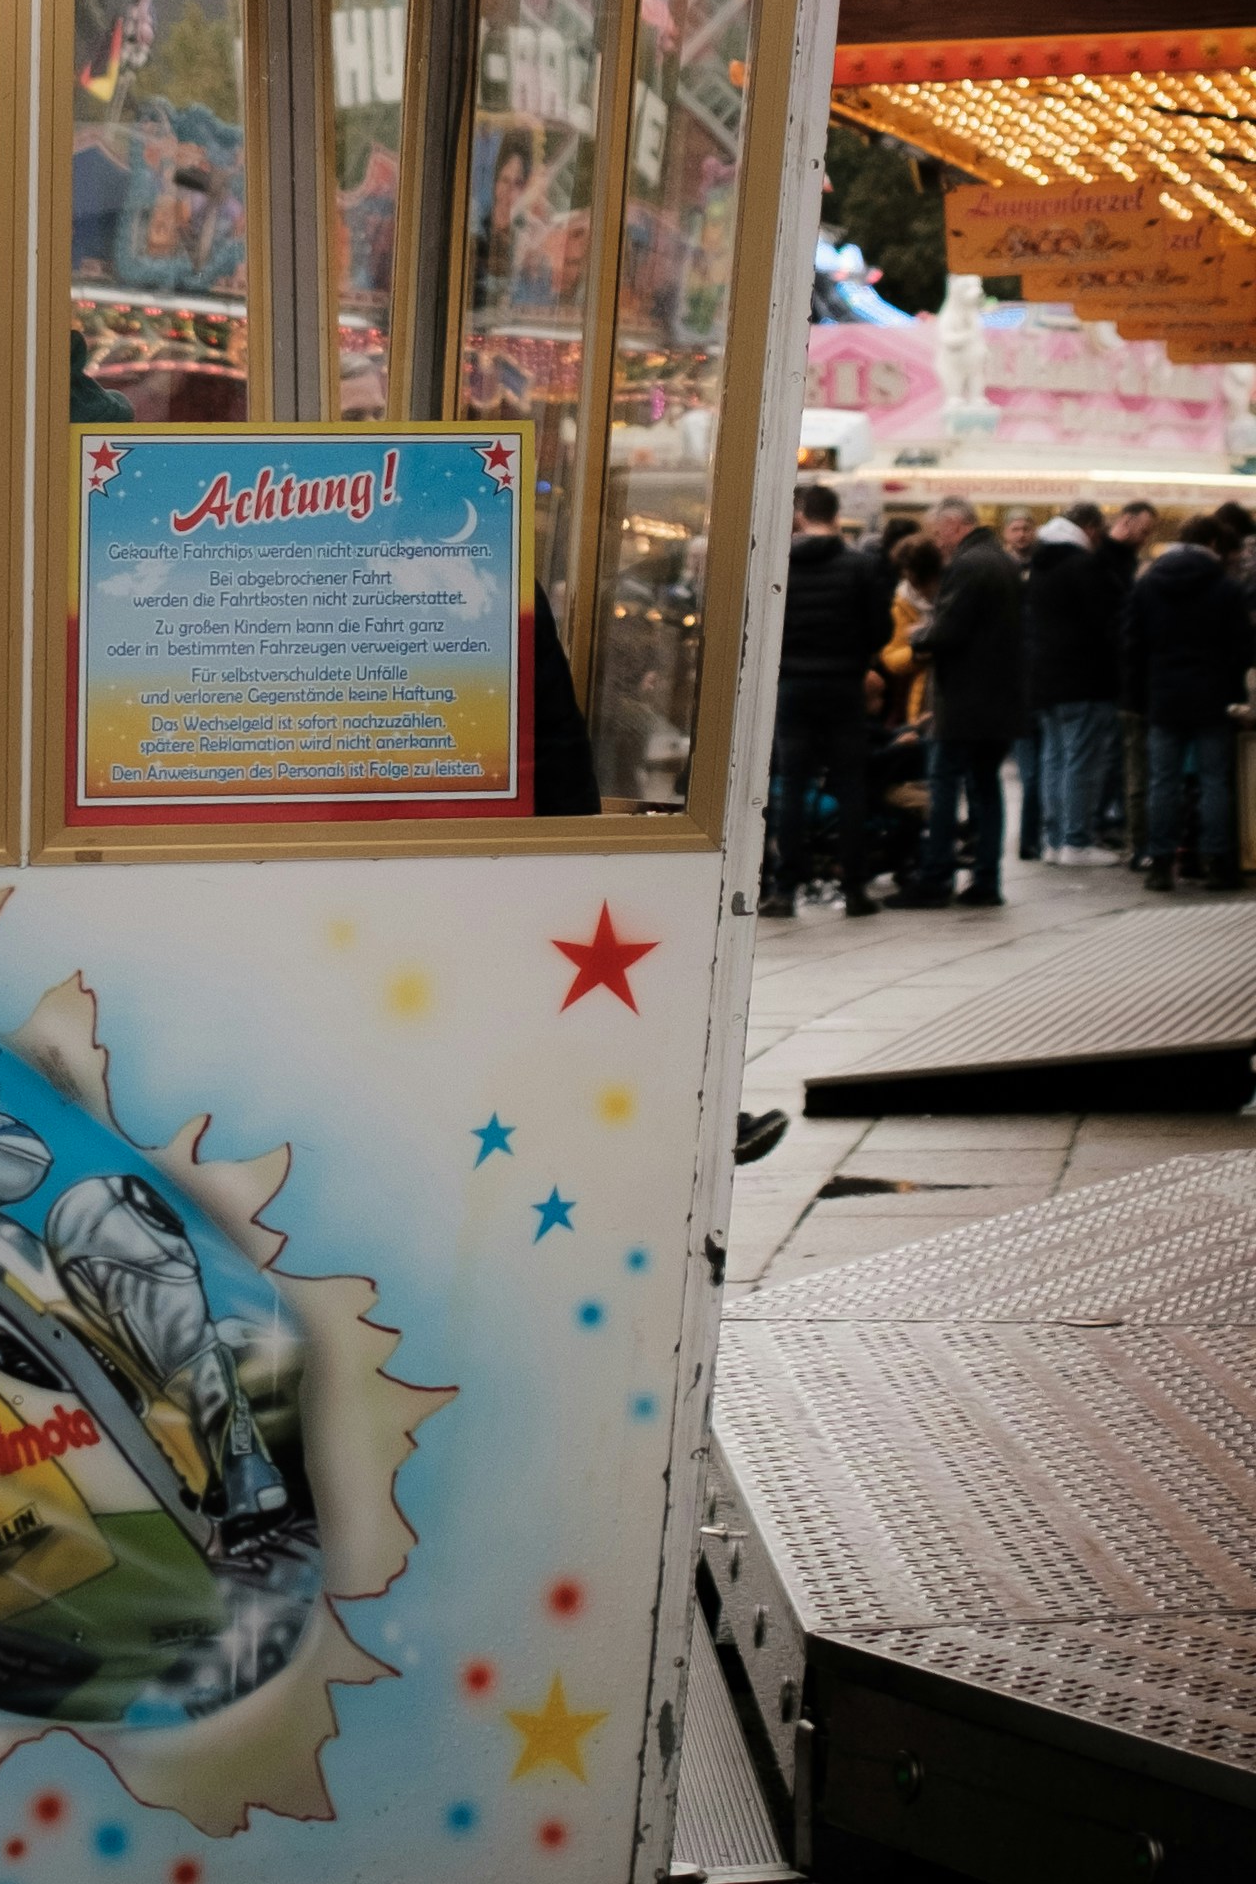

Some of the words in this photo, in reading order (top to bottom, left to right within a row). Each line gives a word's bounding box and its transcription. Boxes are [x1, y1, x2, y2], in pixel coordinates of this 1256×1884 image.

[171, 450, 399, 533] Achtung!
[108, 544, 179, 562] Gekaufte
[183, 544, 254, 562] Fahrchips
[258, 544, 313, 559] werden
[317, 544, 352, 559] nicht
[357, 543, 491, 561] zurückgenommen.
[210, 571, 233, 586] Bei
[238, 570, 347, 590] abgebrochener
[352, 570, 392, 585] Fahrt
[133, 593, 188, 608] werden
[193, 592, 215, 608] die
[220, 592, 309, 608] Fahrtkosten
[313, 591, 348, 606] nicht
[353, 590, 466, 606] zurückerstattet.
[155, 620, 174, 636] Zu
[179, 619, 230, 638] großen
[234, 619, 291, 634] Kindern
[296, 619, 333, 634] kann
[338, 618, 360, 633] die
[365, 618, 404, 633] Fahrt
[409, 621, 445, 636] ganz
[107, 642, 141, 657] oder
[145, 642, 159, 656] in
[168, 640, 255, 656] bestimmten
[259, 640, 347, 657] Fahrzeugen
[351, 640, 428, 656] verweigert
[433, 639, 491, 654] werden.
[192, 667, 216, 683] Für
[221, 667, 351, 683] selbstverschuldete
[356, 666, 408, 682] Unfälle
[141, 690, 170, 706] und
[174, 689, 243, 704] verlorene
[248, 688, 343, 706] Gegenstände
[348, 688, 387, 702] keine
[392, 686, 457, 704] Haftung.
[151, 717, 178, 732] Das
[183, 716, 273, 734] Wechselgeld
[278, 716, 293, 731] ist
[297, 715, 337, 730] sofort
[140, 738, 194, 756] spätere
[199, 737, 295, 753] Reklamation
[299, 736, 331, 751] wird
[336, 736, 371, 750] nicht
[376, 735, 456, 751] anerkannt.
[112, 766, 142, 781] Den
[147, 764, 245, 782] Anweisungen
[249, 764, 273, 779] des
[277, 763, 345, 778] Personals
[349, 763, 365, 777] ist
[369, 762, 409, 780] Folge
[413, 763, 430, 777] zu
[435, 761, 484, 776] leisten.
